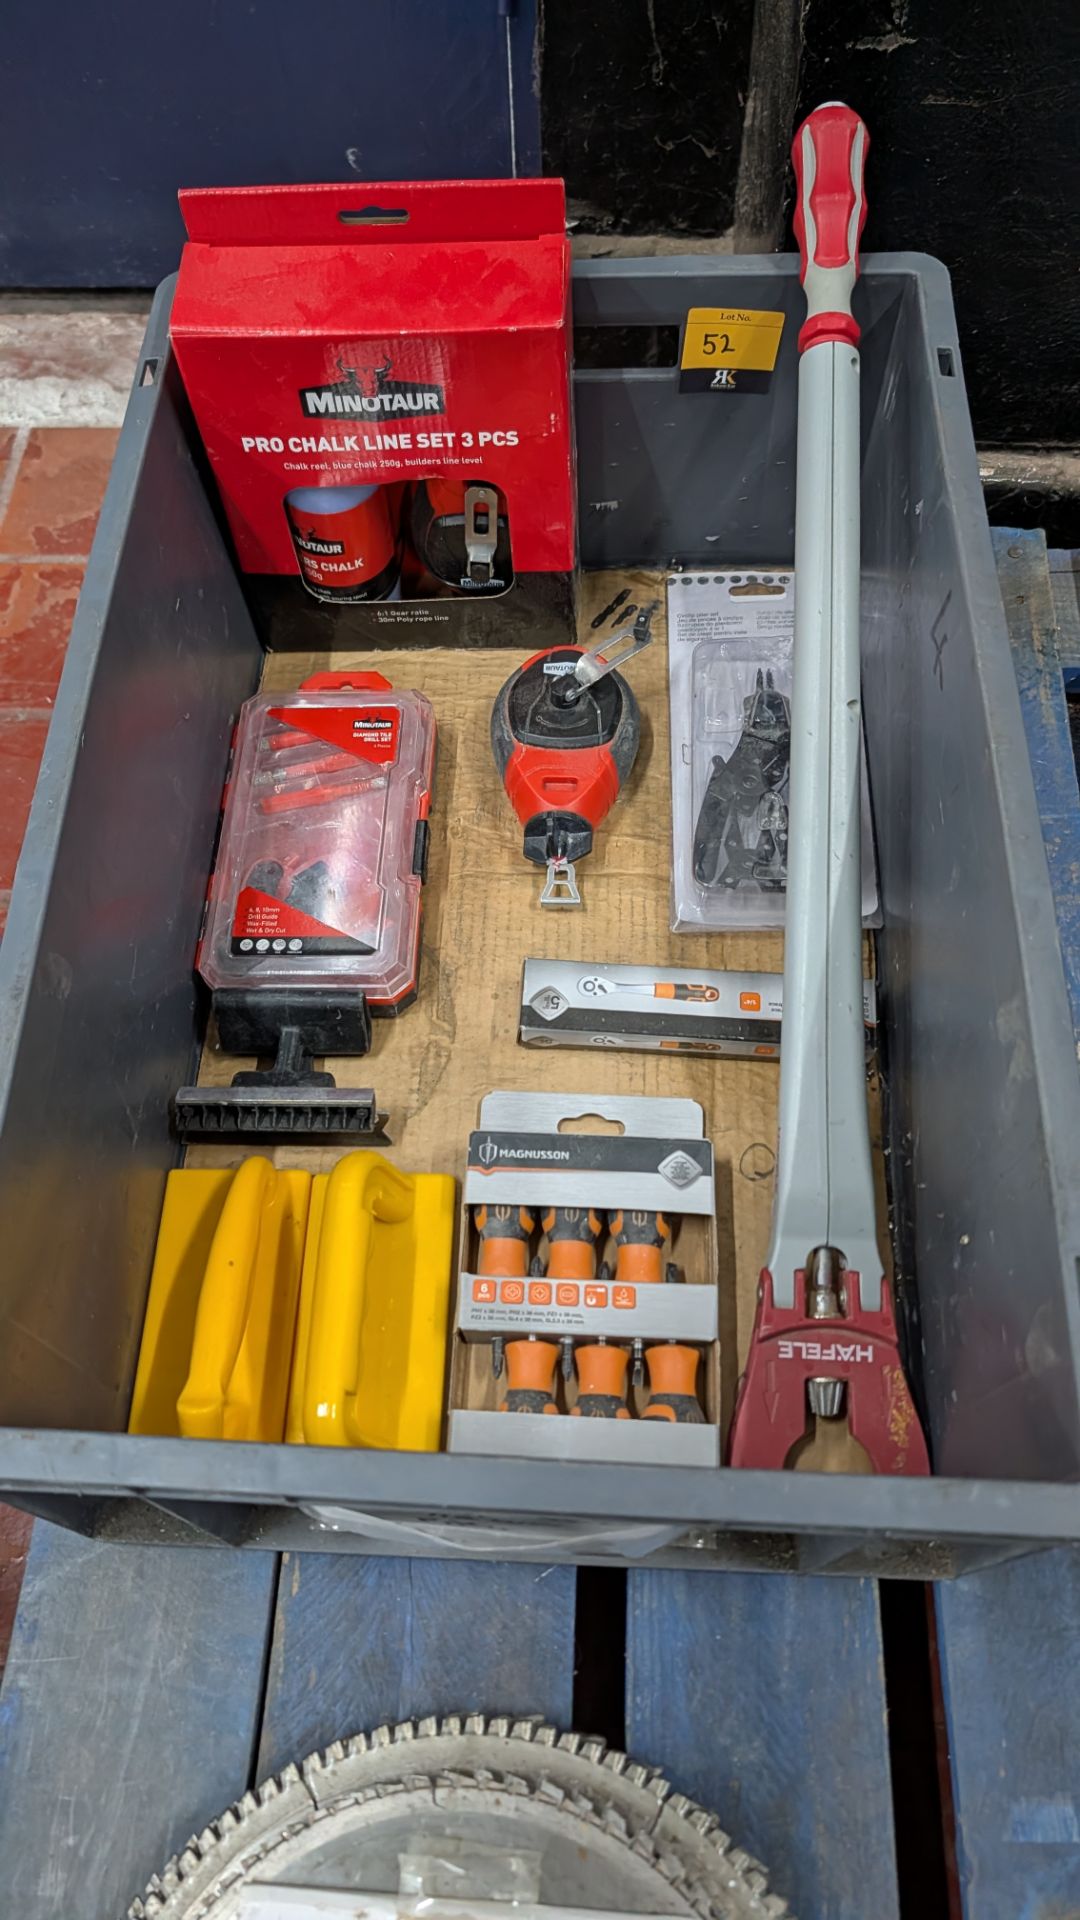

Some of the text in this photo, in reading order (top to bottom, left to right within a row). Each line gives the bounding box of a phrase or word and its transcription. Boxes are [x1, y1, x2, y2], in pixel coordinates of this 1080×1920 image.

[720, 313, 752, 322] Lot No.
[702, 333, 736, 355] 52
[304, 390, 440, 414] MINOTAUR
[241, 430, 520, 453] PRO CHALK LINE SET 3 PCS
[283, 455, 484, 471] Chalk reel, blue chalk 250g, builders line level
[320, 557, 365, 573] CHALK
[390, 609, 409, 617] Gear
[396, 615, 414, 624] Poly
[414, 615, 433, 624] rope
[551, 995, 561, 1010] 5
[499, 1148, 570, 1161] MAGNUSSON
[480, 1282, 488, 1293] 6
[777, 1340, 874, 1363] HÄFELE
